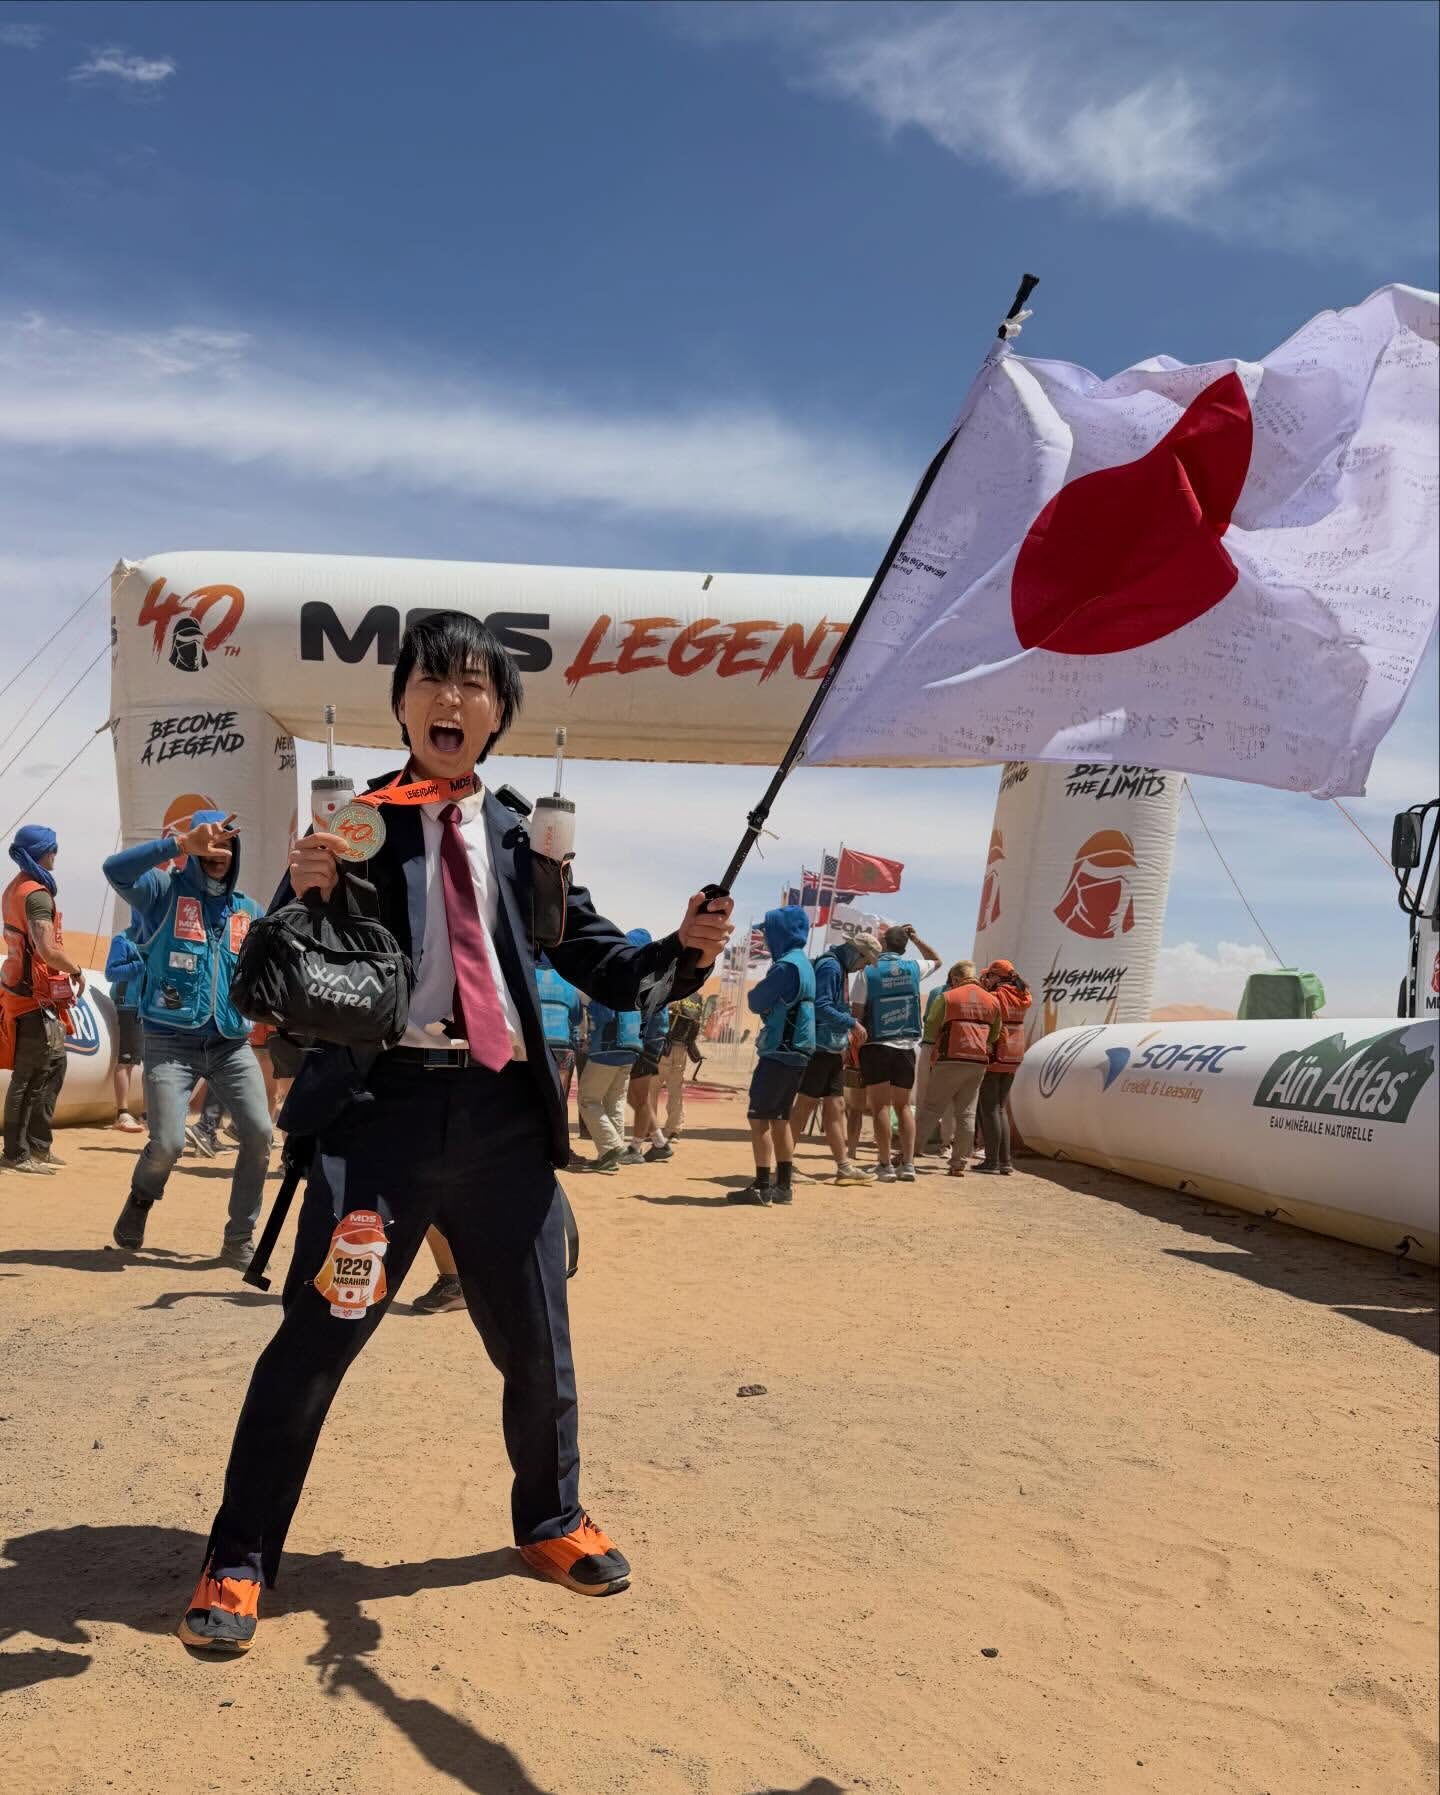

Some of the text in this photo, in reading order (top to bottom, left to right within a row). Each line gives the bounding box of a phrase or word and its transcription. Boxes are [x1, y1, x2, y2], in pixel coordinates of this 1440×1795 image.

[137, 576, 245, 665] 40
[224, 646, 241, 656] TH
[300, 600, 553, 672] MS
[145, 712, 238, 744] BECOME
[141, 734, 245, 767] A LEGEND
[405, 784, 439, 799] LEGENDARY
[1065, 776, 1167, 800] THE LIMITS
[1042, 966, 1128, 988] HIGHWAY
[308, 983, 372, 1009] ULTRA
[1042, 986, 1118, 1004] TO HELL
[1132, 1044, 1248, 1074] SOFAC
[1266, 1044, 1409, 1115] Aïn Atlas
[1160, 1083, 1203, 1104] Leasing
[1270, 1115, 1374, 1143] EAU MINÉRALE NATURELLE
[351, 1214, 377, 1223] MDS
[335, 1257, 372, 1276] 1229
[333, 1276, 371, 1287] MASAHIRO
